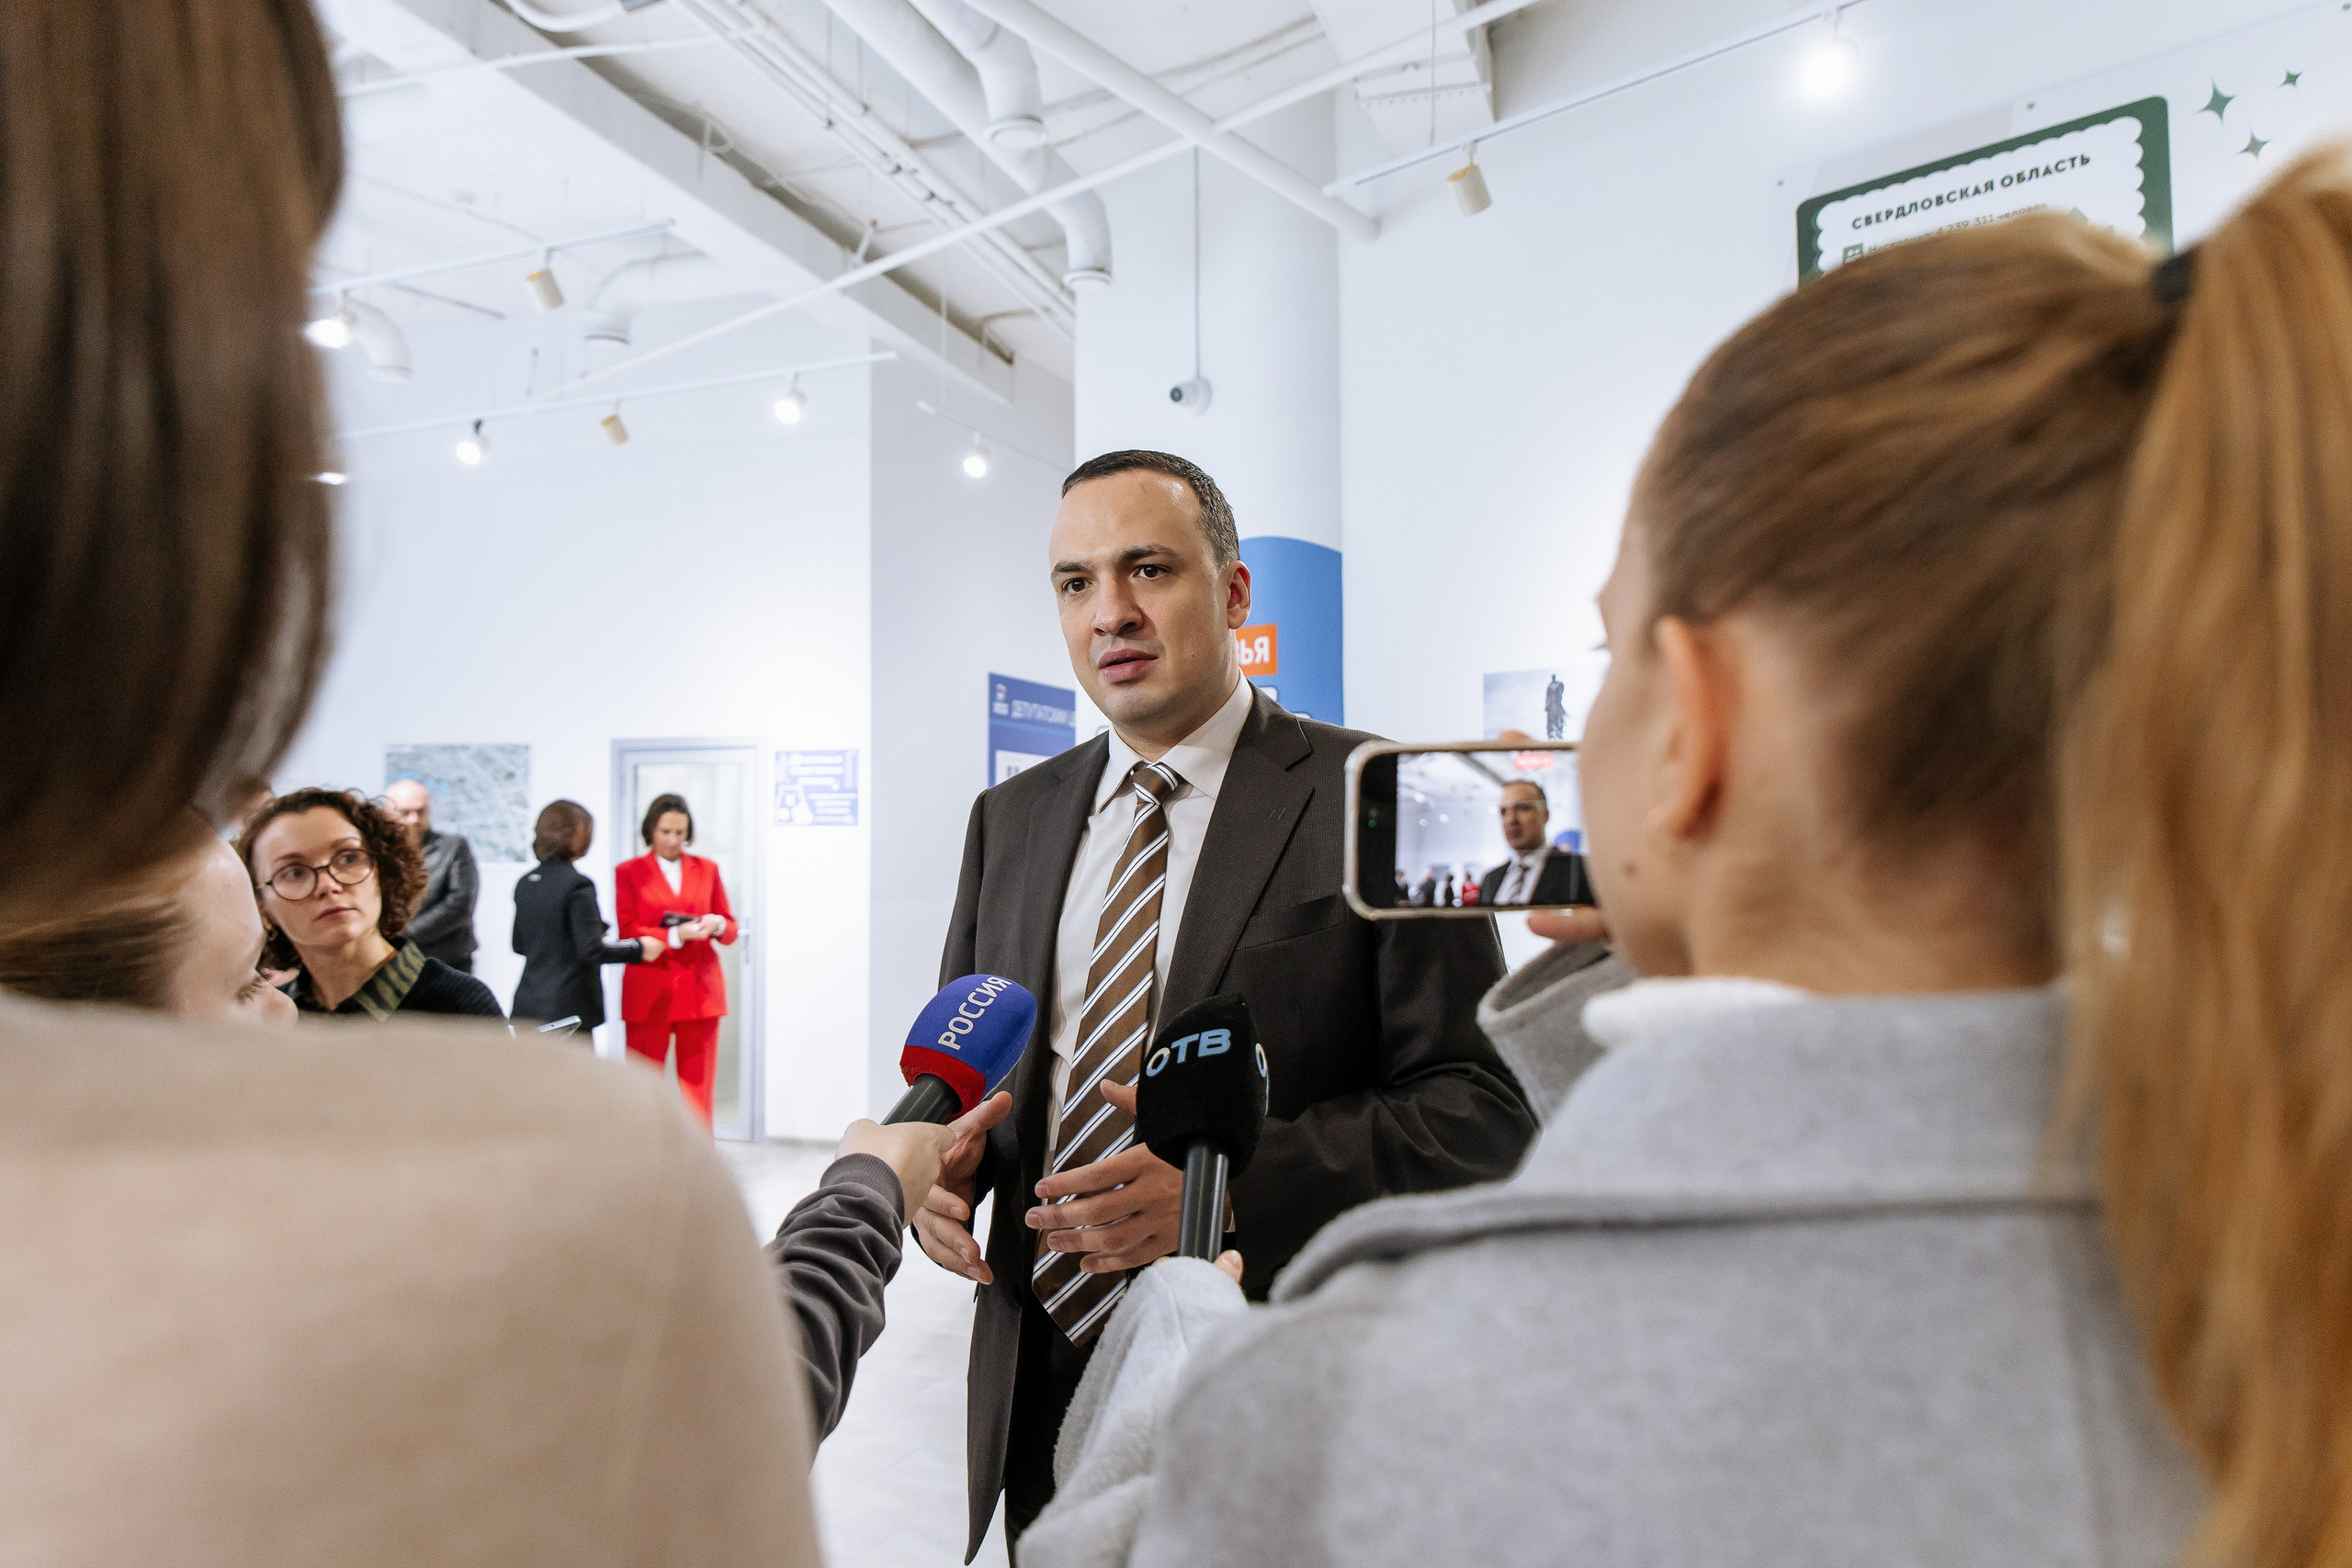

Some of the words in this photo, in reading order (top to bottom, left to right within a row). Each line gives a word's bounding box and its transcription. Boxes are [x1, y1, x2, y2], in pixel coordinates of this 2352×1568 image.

[1852, 180, 1995, 230] СВЕРДЛОВСКАЯ
[2000, 153, 2092, 188] ОБЛАСТЬ
[1238, 636, 1270, 666] ЬЯ
[937, 976, 1012, 1051] РОССИЯ
[1146, 1028, 1231, 1077] ОТВ
